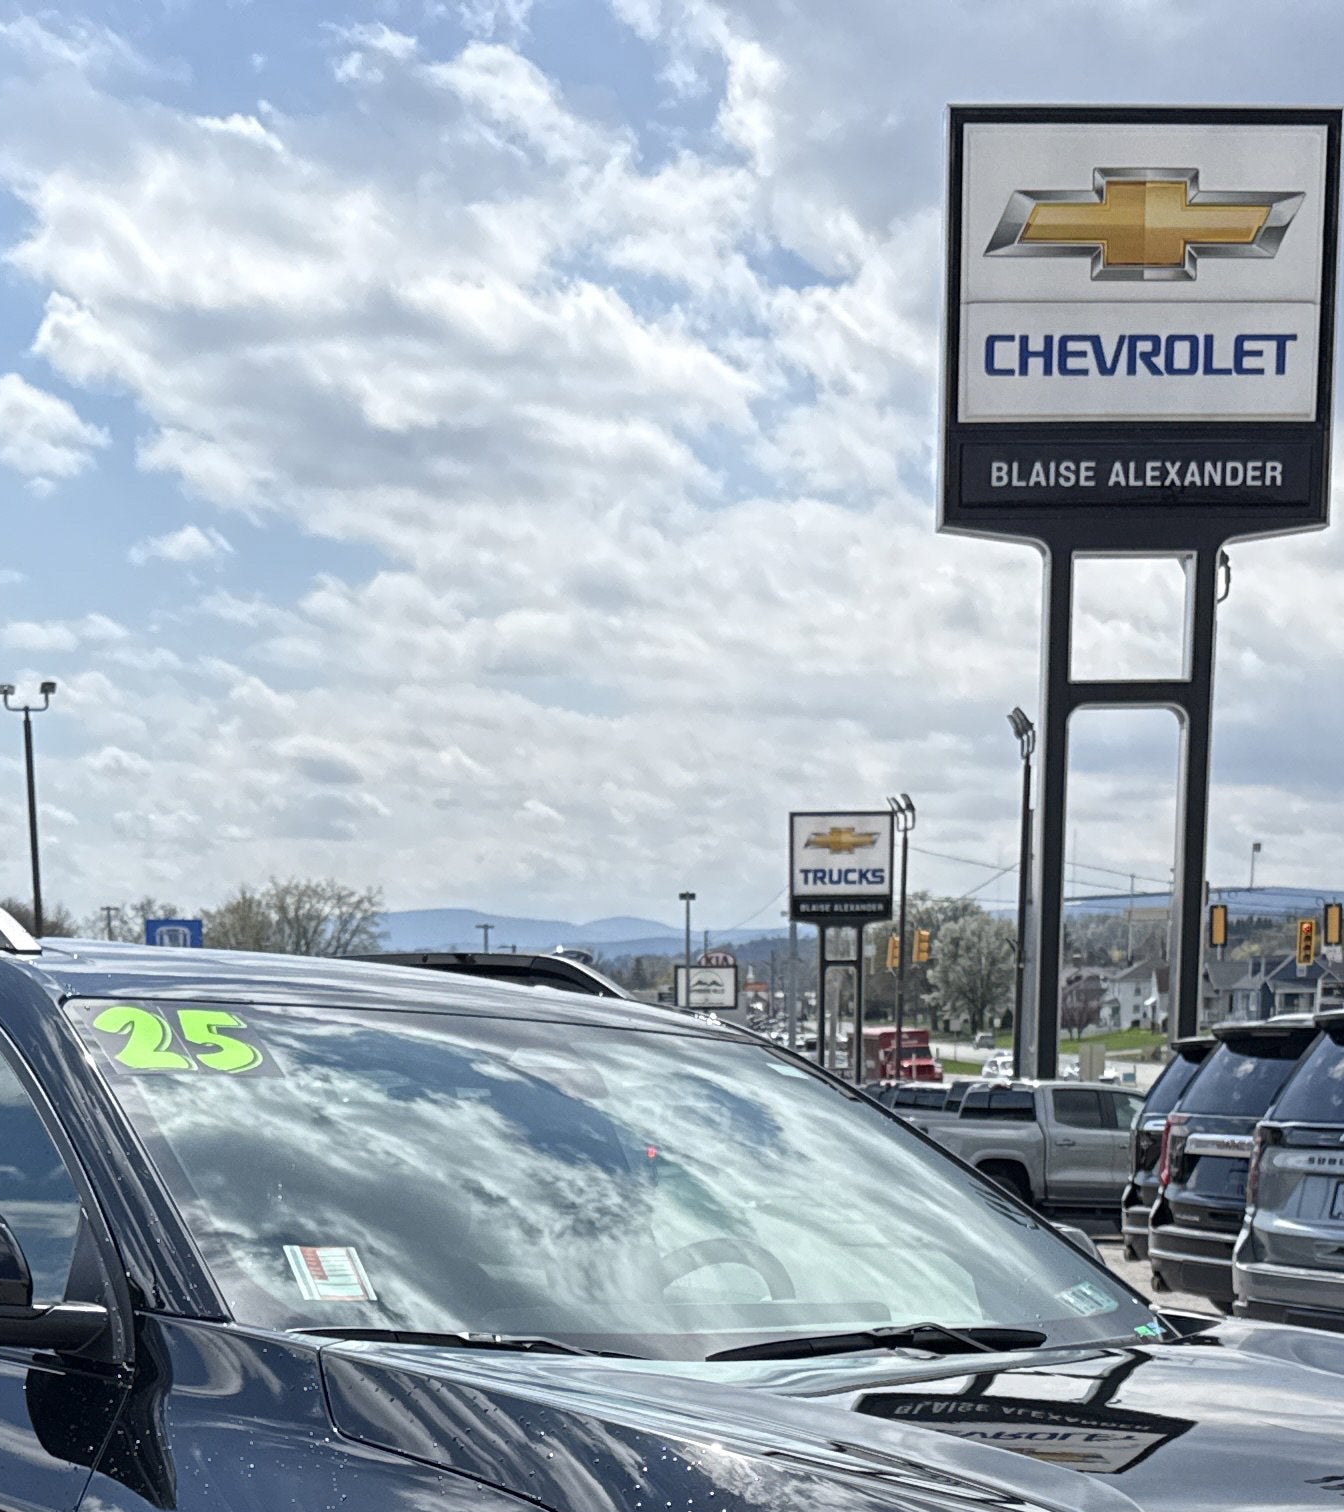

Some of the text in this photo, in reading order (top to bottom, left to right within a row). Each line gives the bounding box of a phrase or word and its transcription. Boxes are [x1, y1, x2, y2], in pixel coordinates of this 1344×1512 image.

[984, 334, 1298, 377] CHEVROLET
[990, 461, 1284, 488] BLAISE ALEXANDER
[799, 868, 885, 886] TRUCKS
[799, 903, 884, 913] BLAISE ALEXANDER
[93, 1005, 264, 1074] 25
